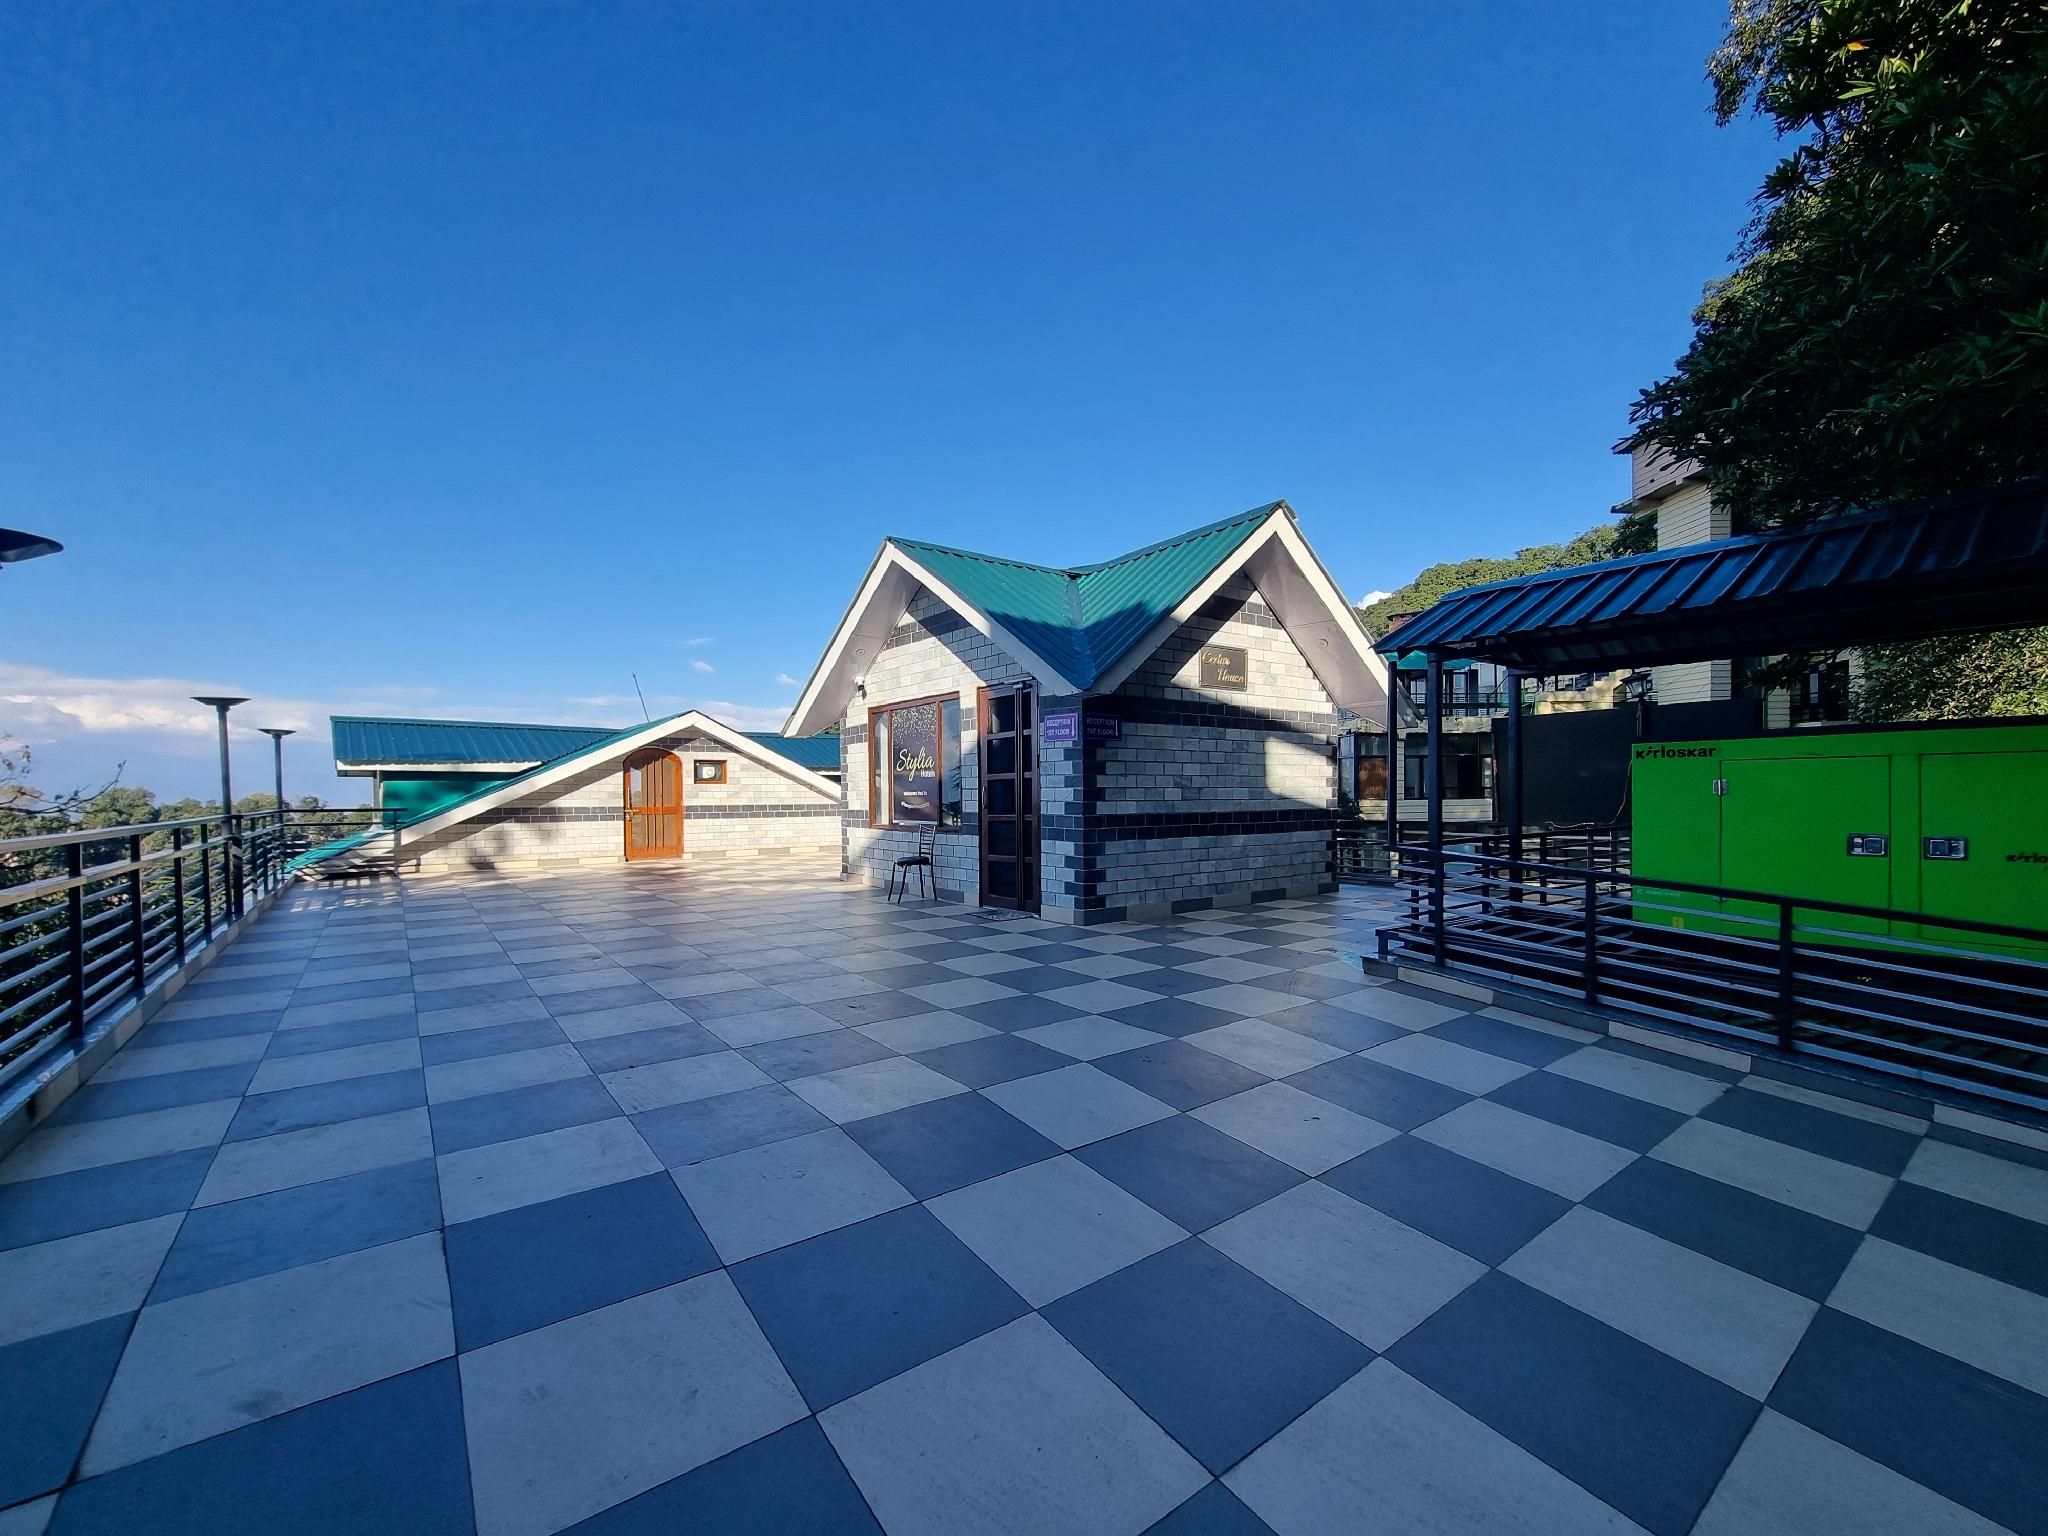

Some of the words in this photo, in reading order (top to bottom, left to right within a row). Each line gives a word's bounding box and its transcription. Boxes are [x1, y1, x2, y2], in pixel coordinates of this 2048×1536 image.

[1046, 718, 1071, 727] RECEPTION
[1055, 728, 1070, 736] FLOOR
[1097, 728, 1114, 736] FLOOR
[896, 746, 935, 781] Stylia
[920, 770, 936, 778] Hotels
